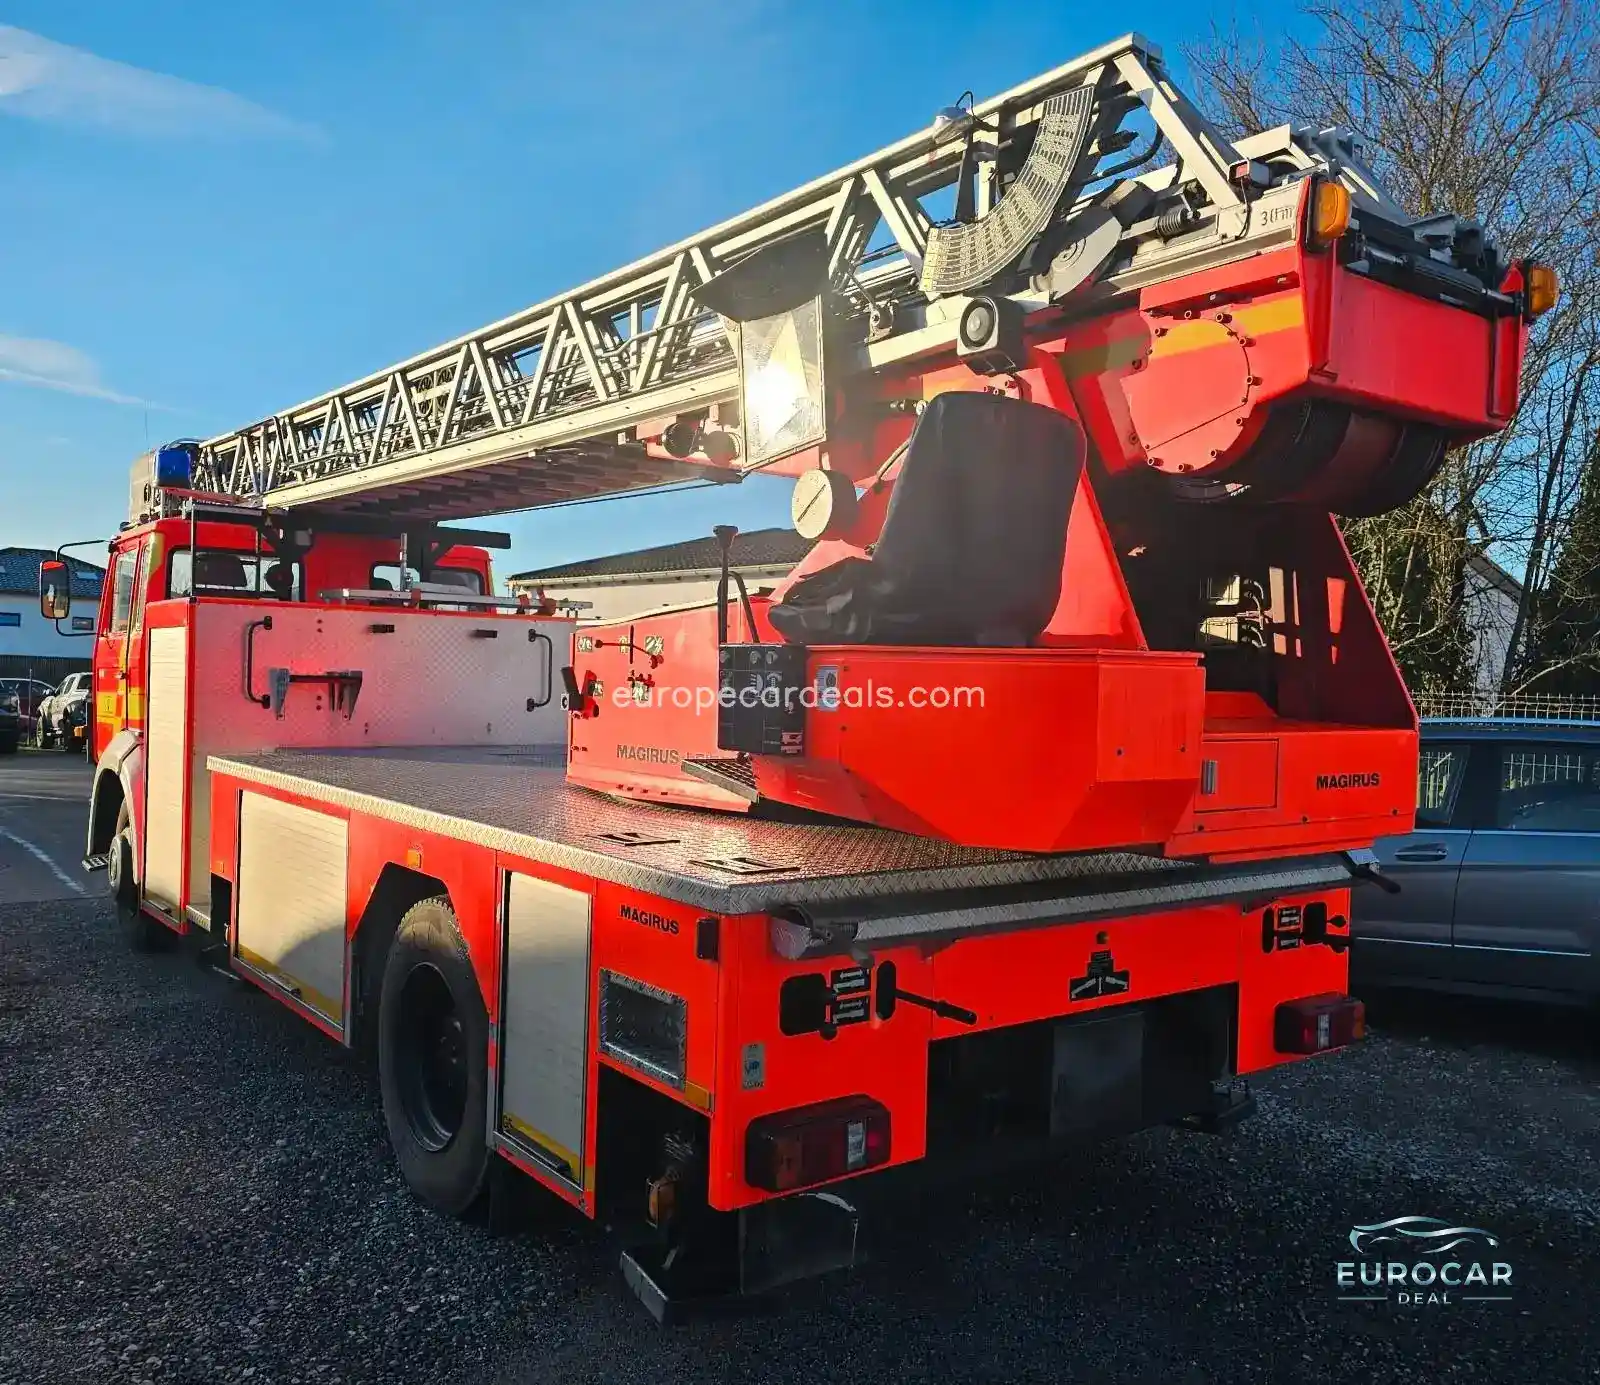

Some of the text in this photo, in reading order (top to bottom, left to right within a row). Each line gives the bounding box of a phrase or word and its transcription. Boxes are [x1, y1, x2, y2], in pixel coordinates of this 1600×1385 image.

[616, 744, 680, 764] MAGIRUS
[1316, 772, 1380, 790] MAGIRUS
[620, 904, 680, 935] MAGIRUS
